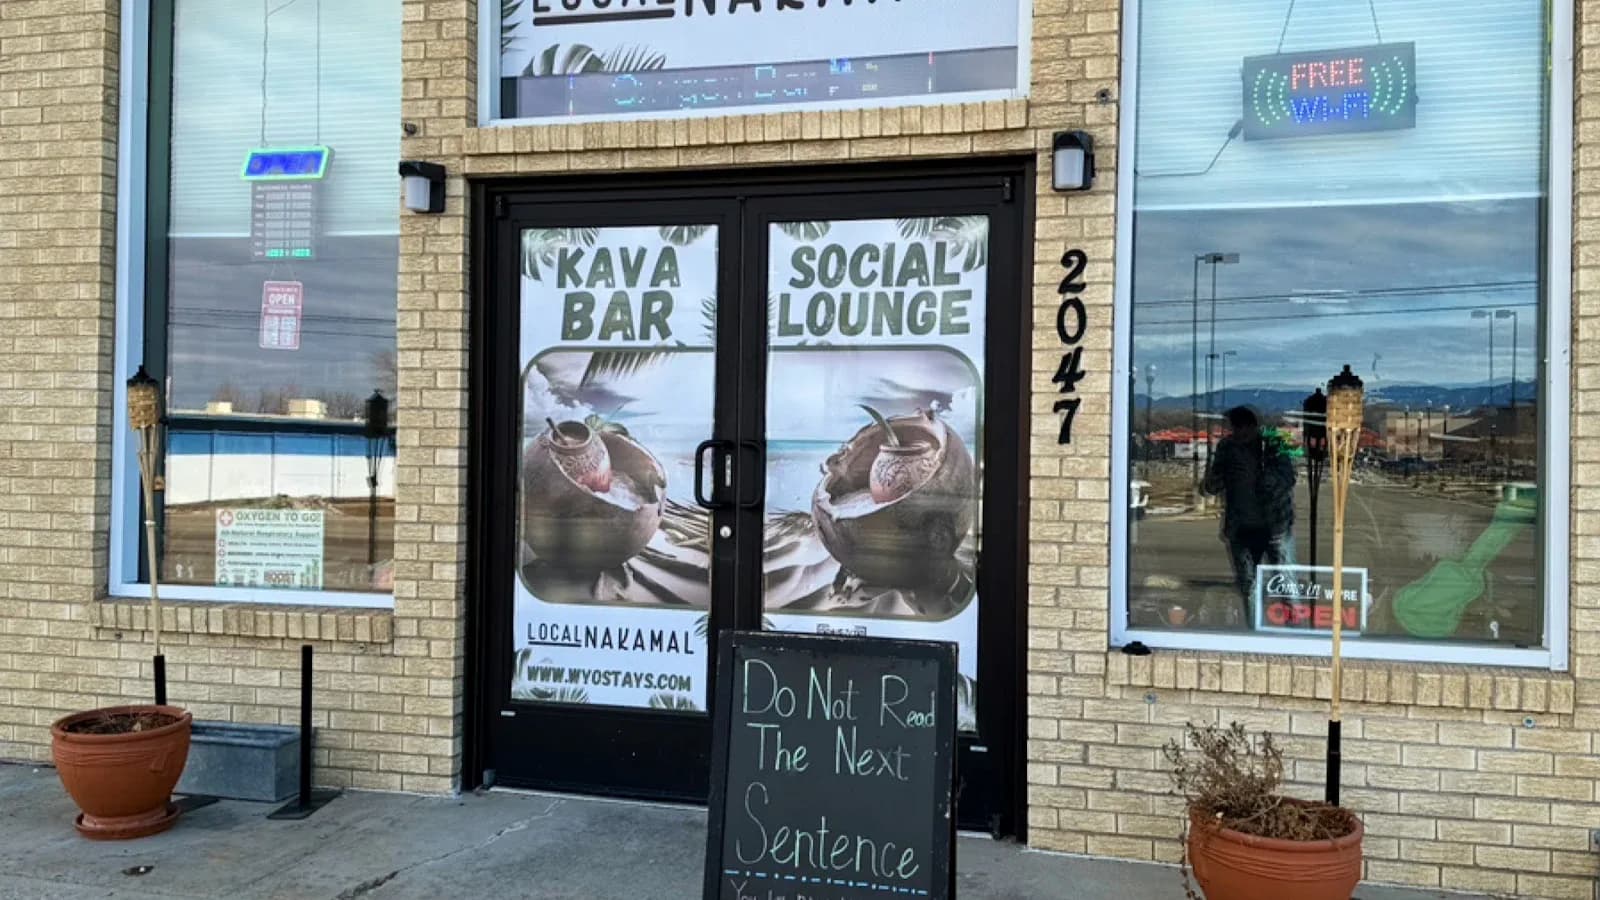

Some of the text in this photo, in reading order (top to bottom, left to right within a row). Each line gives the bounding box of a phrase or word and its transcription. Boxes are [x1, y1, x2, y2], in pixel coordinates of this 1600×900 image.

[1291, 57, 1364, 90] FREE
[557, 246, 681, 290] KAVA
[789, 242, 962, 290] SOCIAL
[268, 294, 295, 308] OPEN
[561, 290, 675, 342] BAR
[777, 290, 973, 338] LOUNGE
[1052, 249, 1087, 445] 2047
[236, 512, 281, 521] OXYGEN
[284, 513, 299, 521] TO
[1306, 582, 1322, 598] in
[1324, 589, 1358, 601] W'RE
[1266, 602, 1357, 629] OPEN
[527, 665, 692, 692] WWW.WYOSTAYS.COM
[742, 658, 936, 729] Do Not Read
[747, 722, 911, 781] The Next
[735, 781, 920, 880] Sentence
